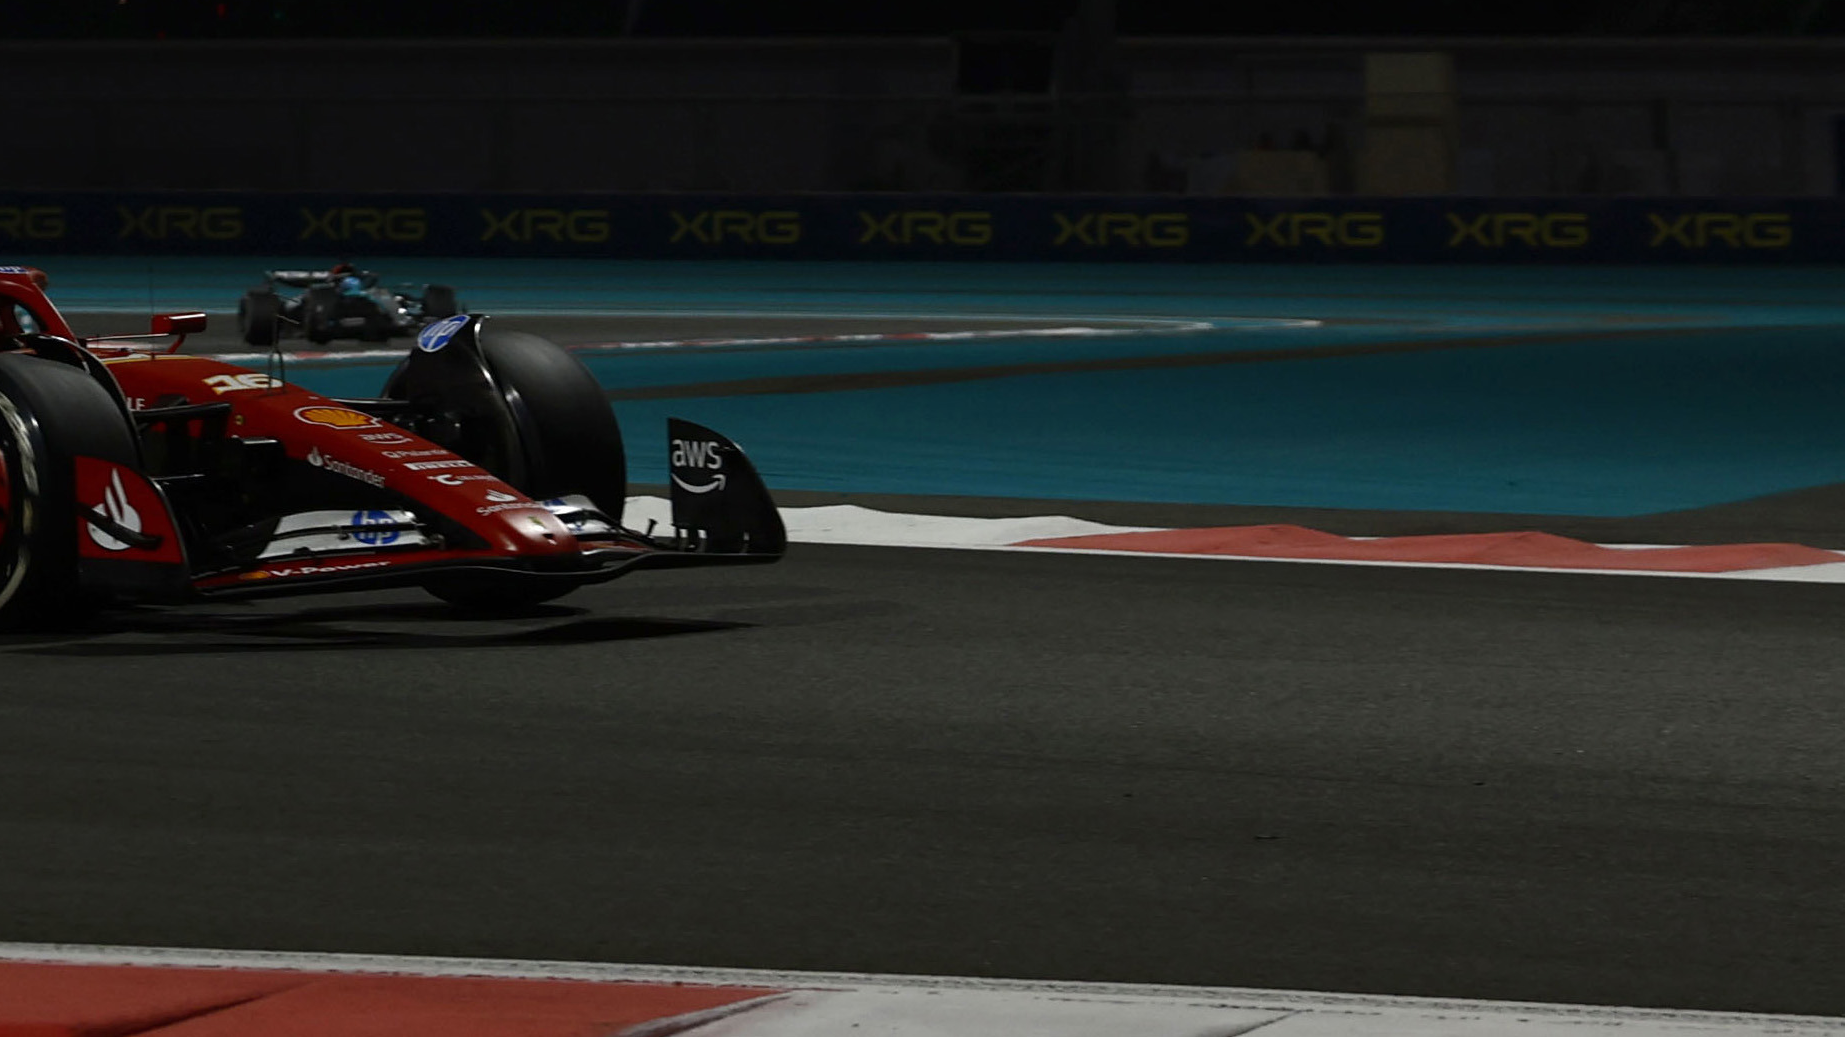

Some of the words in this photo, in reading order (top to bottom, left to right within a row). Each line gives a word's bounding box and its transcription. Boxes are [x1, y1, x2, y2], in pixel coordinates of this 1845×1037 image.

[116, 206, 245, 240] XRG
[300, 207, 428, 242] XRG
[479, 208, 612, 243] XRG
[668, 209, 803, 245] XRG
[858, 211, 993, 246] XRG
[1053, 212, 1190, 247] XRG
[1245, 212, 1385, 247] XRG
[1444, 212, 1590, 247] XRG
[1648, 212, 1792, 247] XRG
[201, 372, 284, 396] 16
[323, 453, 386, 489] Santander
[671, 439, 725, 470] aws
[269, 560, 392, 577] V-Power
